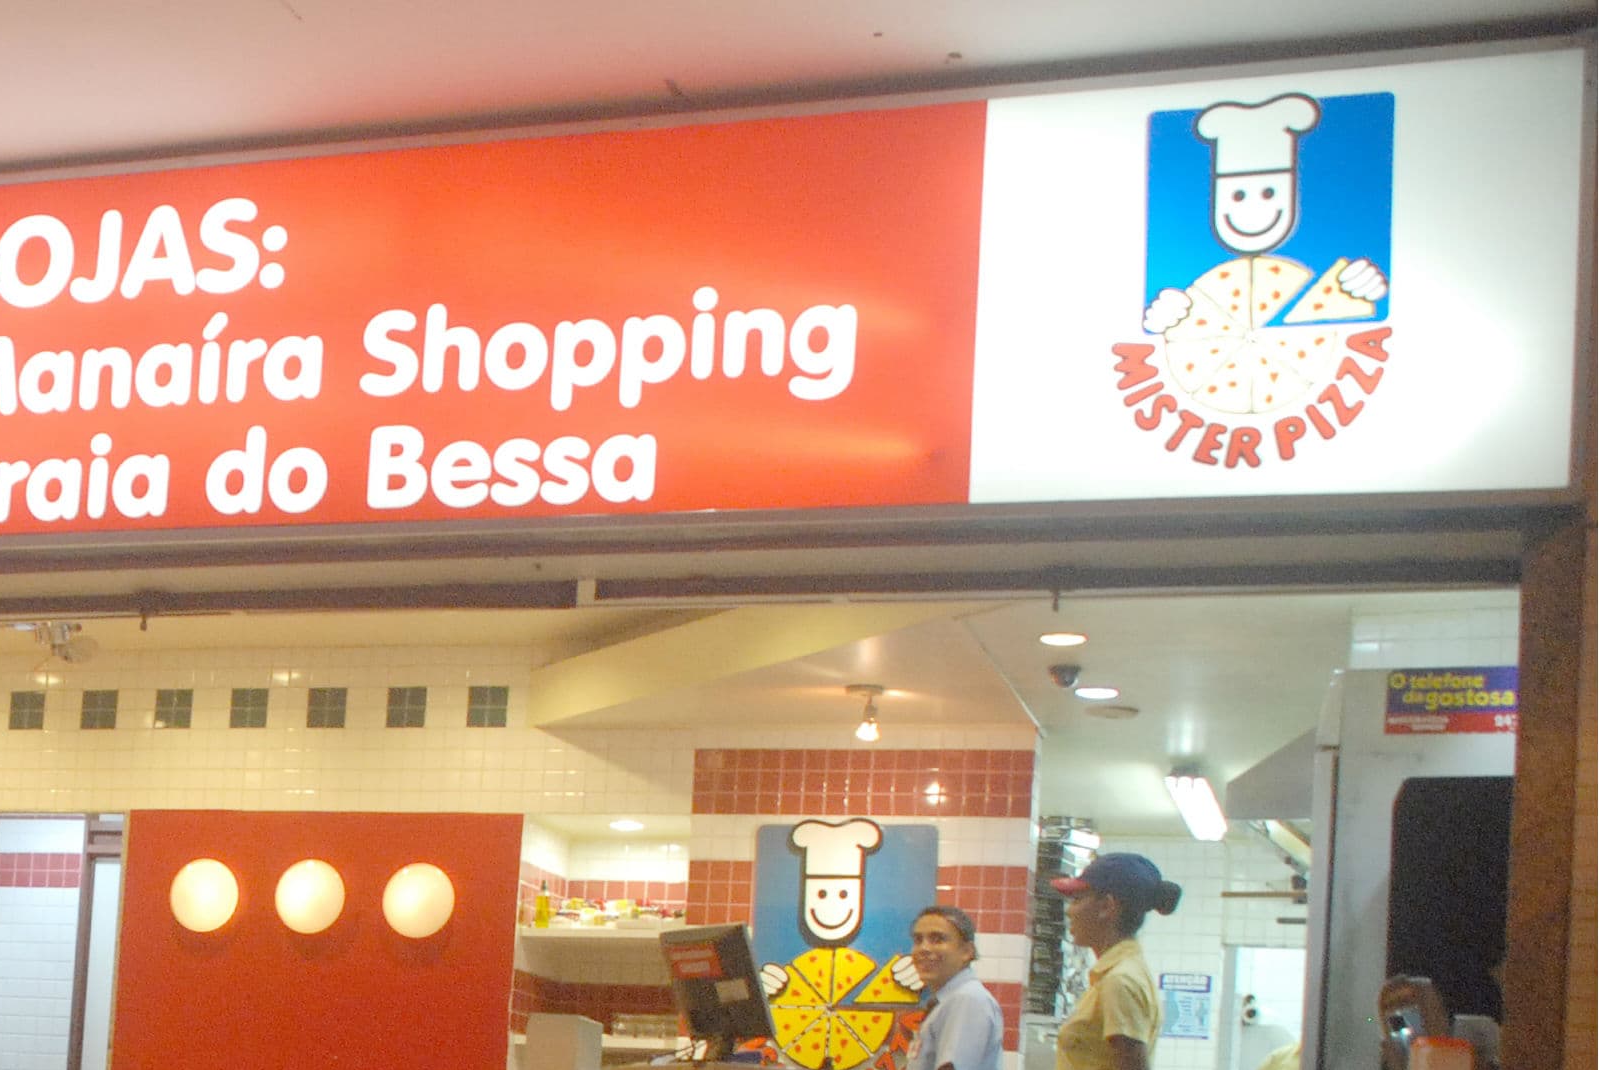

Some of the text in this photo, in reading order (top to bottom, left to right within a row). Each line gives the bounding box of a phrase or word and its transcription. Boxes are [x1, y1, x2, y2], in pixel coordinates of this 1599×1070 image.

[359, 285, 859, 412] Shopping
[1111, 327, 1393, 469] MISTER PIZZA
[205, 424, 328, 514] do
[366, 424, 658, 509] Bessa
[1410, 672, 1484, 689] telefone
[1425, 689, 1516, 711] gostosa
